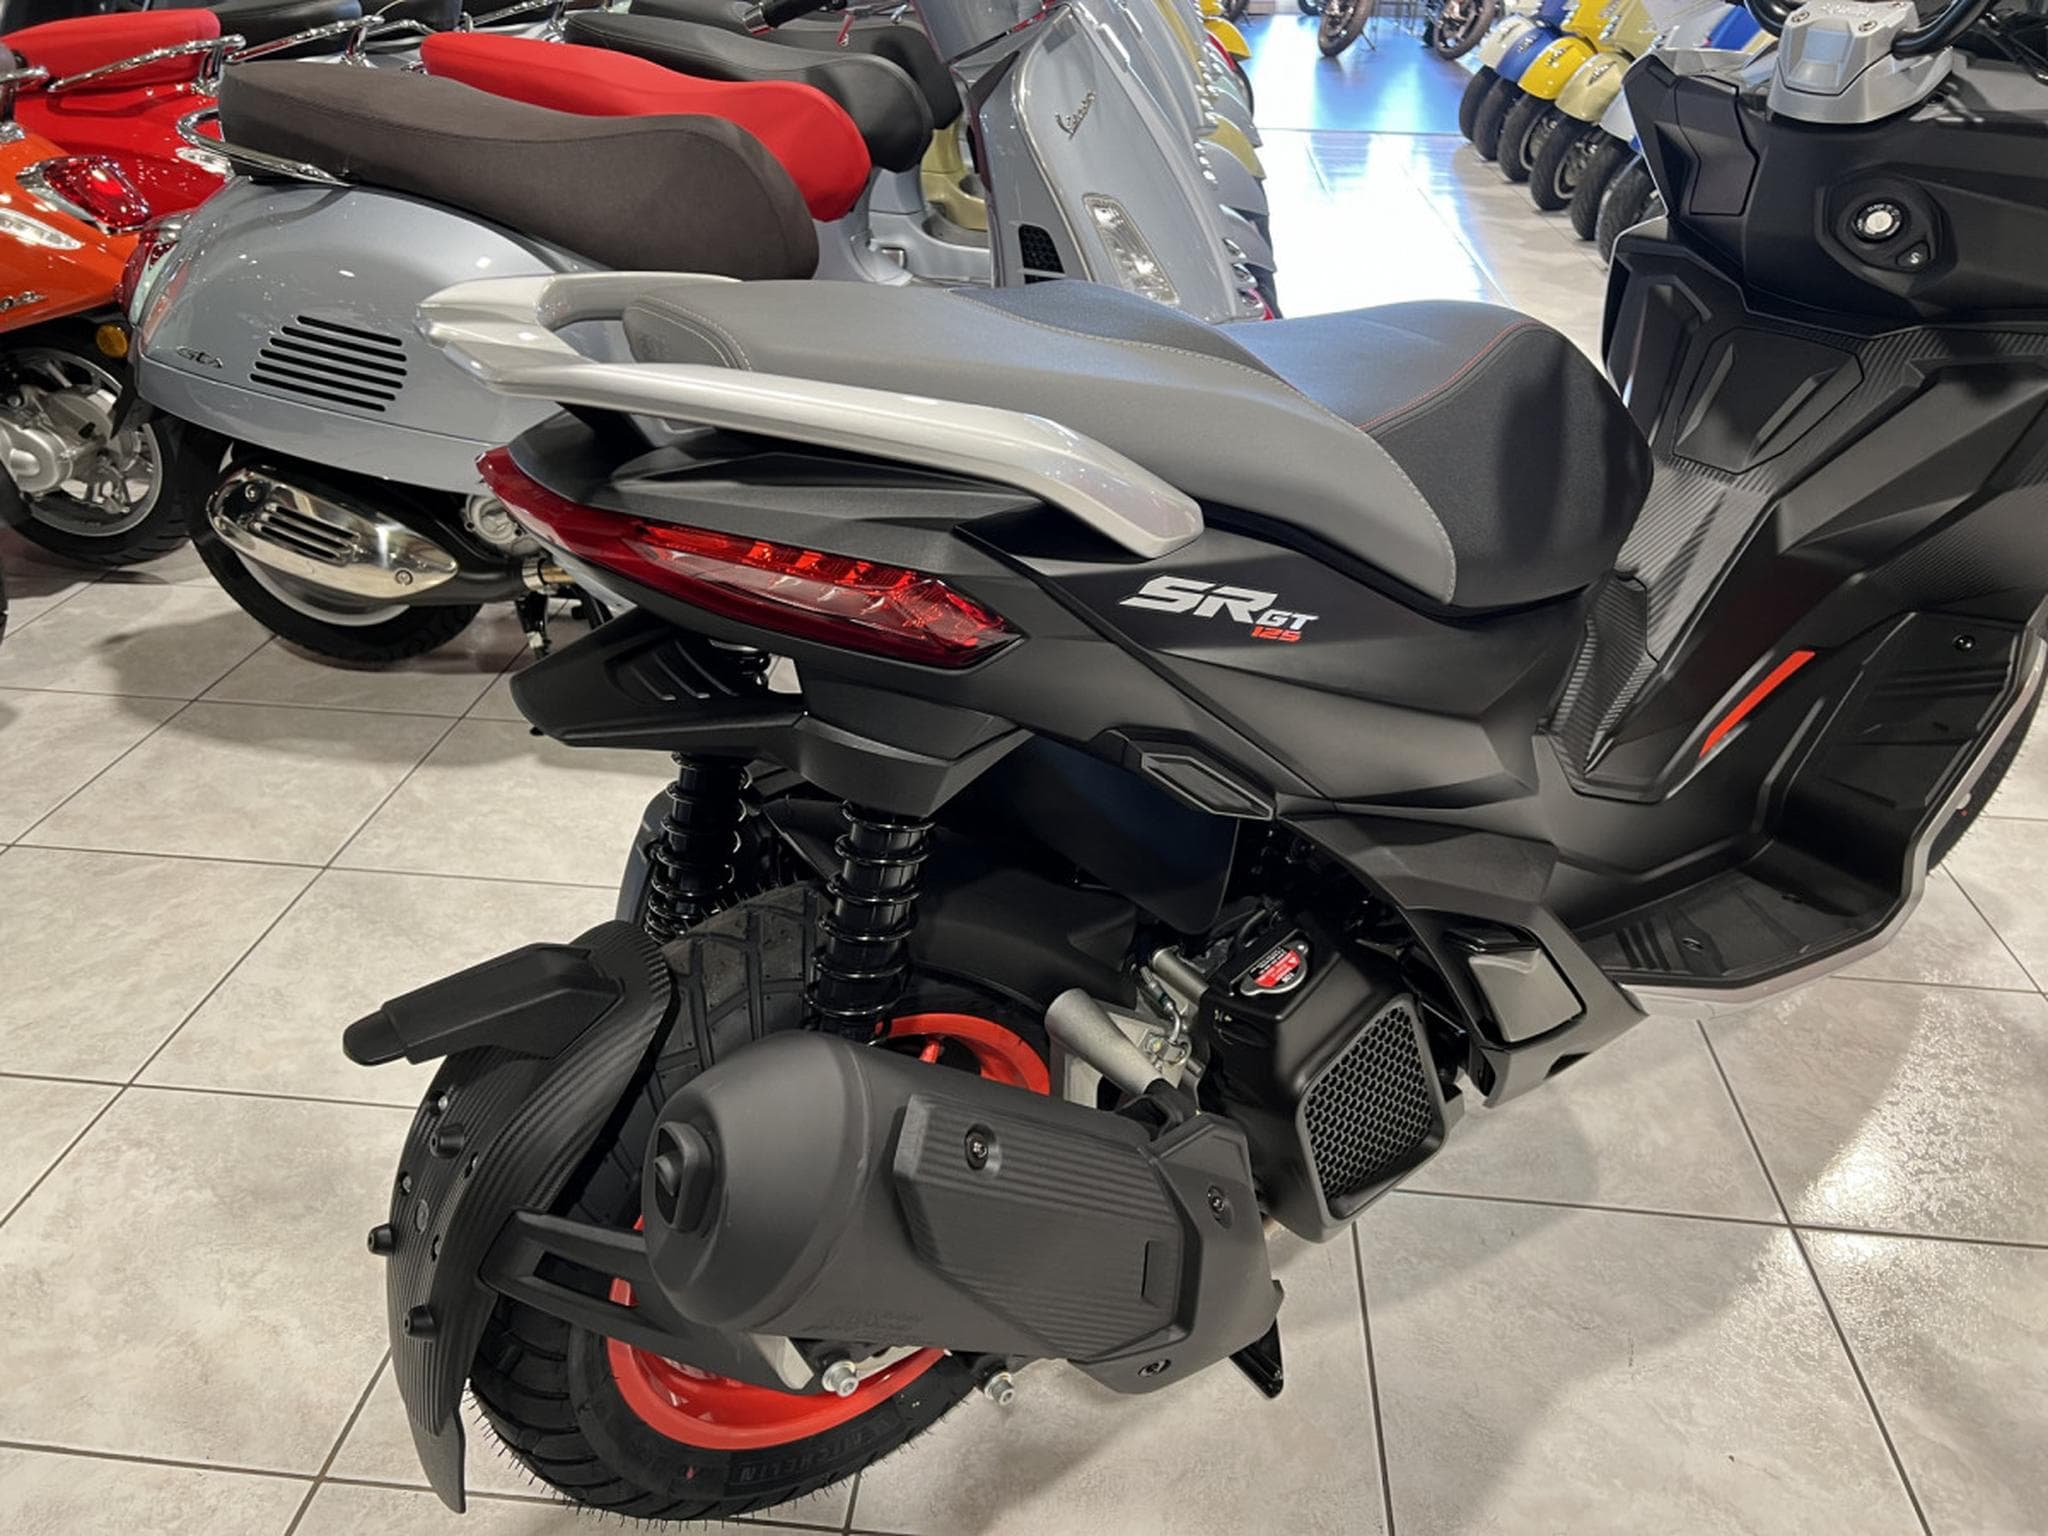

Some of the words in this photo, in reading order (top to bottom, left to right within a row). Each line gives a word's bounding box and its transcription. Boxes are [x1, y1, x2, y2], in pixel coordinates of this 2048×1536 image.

[1119, 575, 1278, 623] SR
[1256, 608, 1319, 630] GT
[1251, 626, 1301, 643] 125
